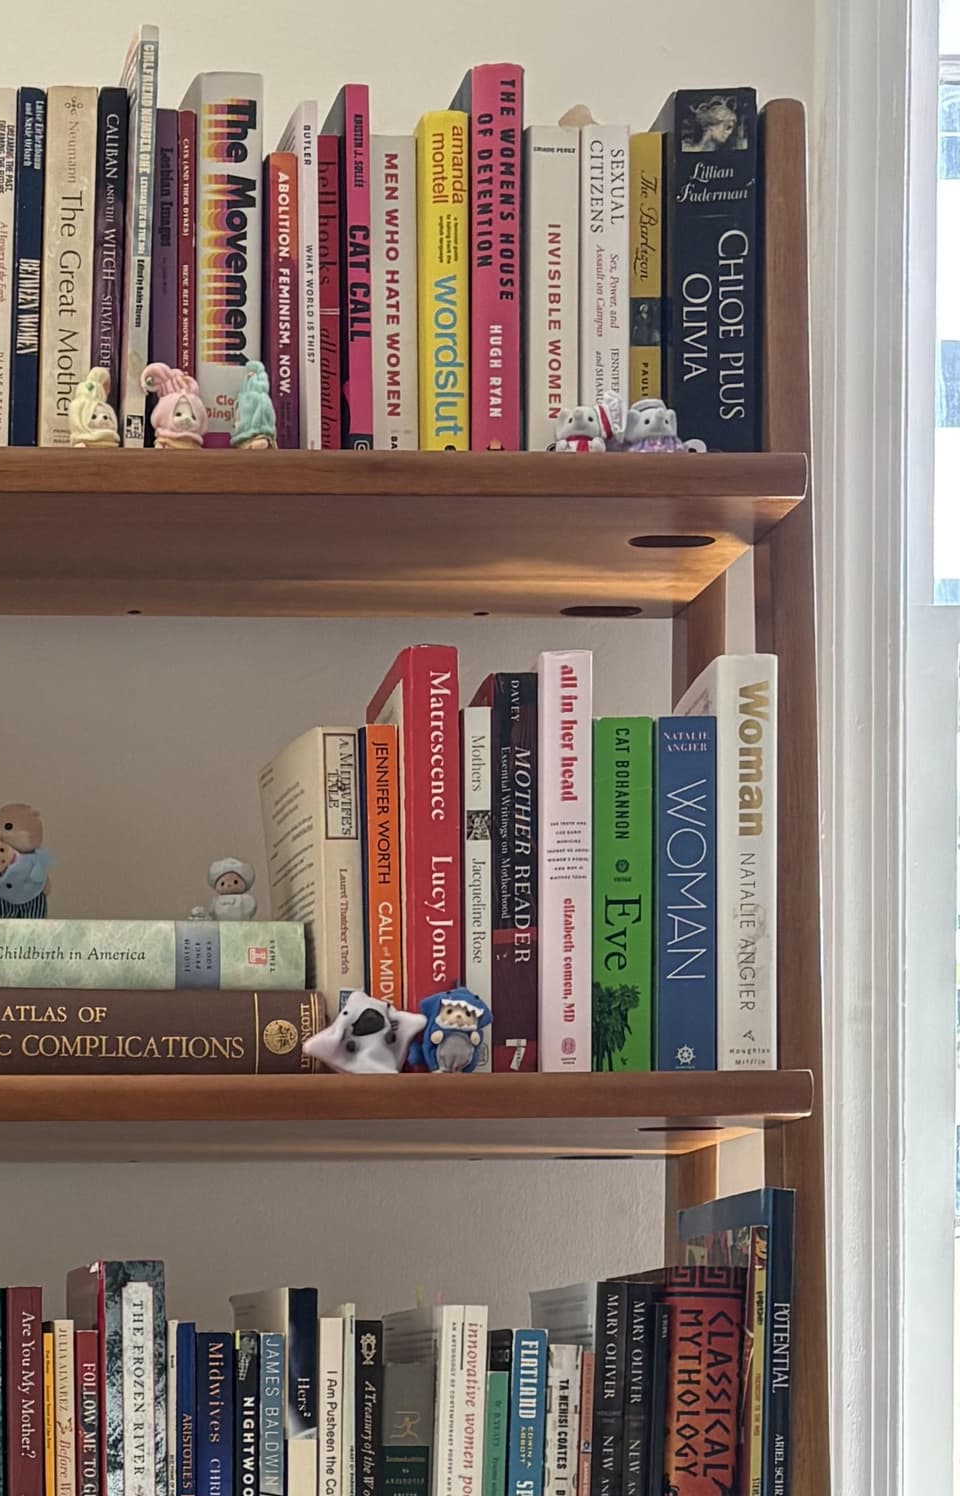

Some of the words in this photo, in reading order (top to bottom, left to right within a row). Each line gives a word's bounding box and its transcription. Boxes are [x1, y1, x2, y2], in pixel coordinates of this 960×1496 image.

[386, 153, 398, 200] MEN
[677, 180, 748, 203] Faderman
[690, 162, 734, 179] Lillian
[385, 208, 399, 261] WHO
[385, 270, 399, 325] HATE
[718, 230, 748, 340] CHLOE
[434, 274, 464, 436] wordslut
[683, 274, 712, 382] OLIVIA
[385, 333, 400, 416] WOMEN
[720, 351, 745, 420] PLUS
[429, 670, 451, 821] Matrescence
[616, 727, 630, 753] CAT
[738, 680, 770, 836] Woman
[371, 741, 389, 816] JENNIFER
[616, 760, 630, 840] BOHANNON
[377, 820, 391, 884] WORTH
[425, 856, 452, 912] Lucy
[666, 779, 707, 979] WOMAN
[69, 947, 82, 961] in
[87, 946, 145, 962] America
[426, 917, 453, 982] Jones
[604, 895, 642, 972] Eve
[1, 1005, 67, 1023] ATLAS
[79, 1008, 107, 1023] OF
[22, 1034, 244, 1059] COMPLICATIONS
[265, 1338, 280, 1398] JAMES
[327, 1378, 337, 1398] Am
[675, 1308, 703, 1477] MYTHOLOGY
[706, 1310, 735, 1478] CLASSICAL
[265, 1407, 280, 1488] BALDWIN
[326, 1402, 337, 1452] Pusheen
[326, 1456, 336, 1475] the
